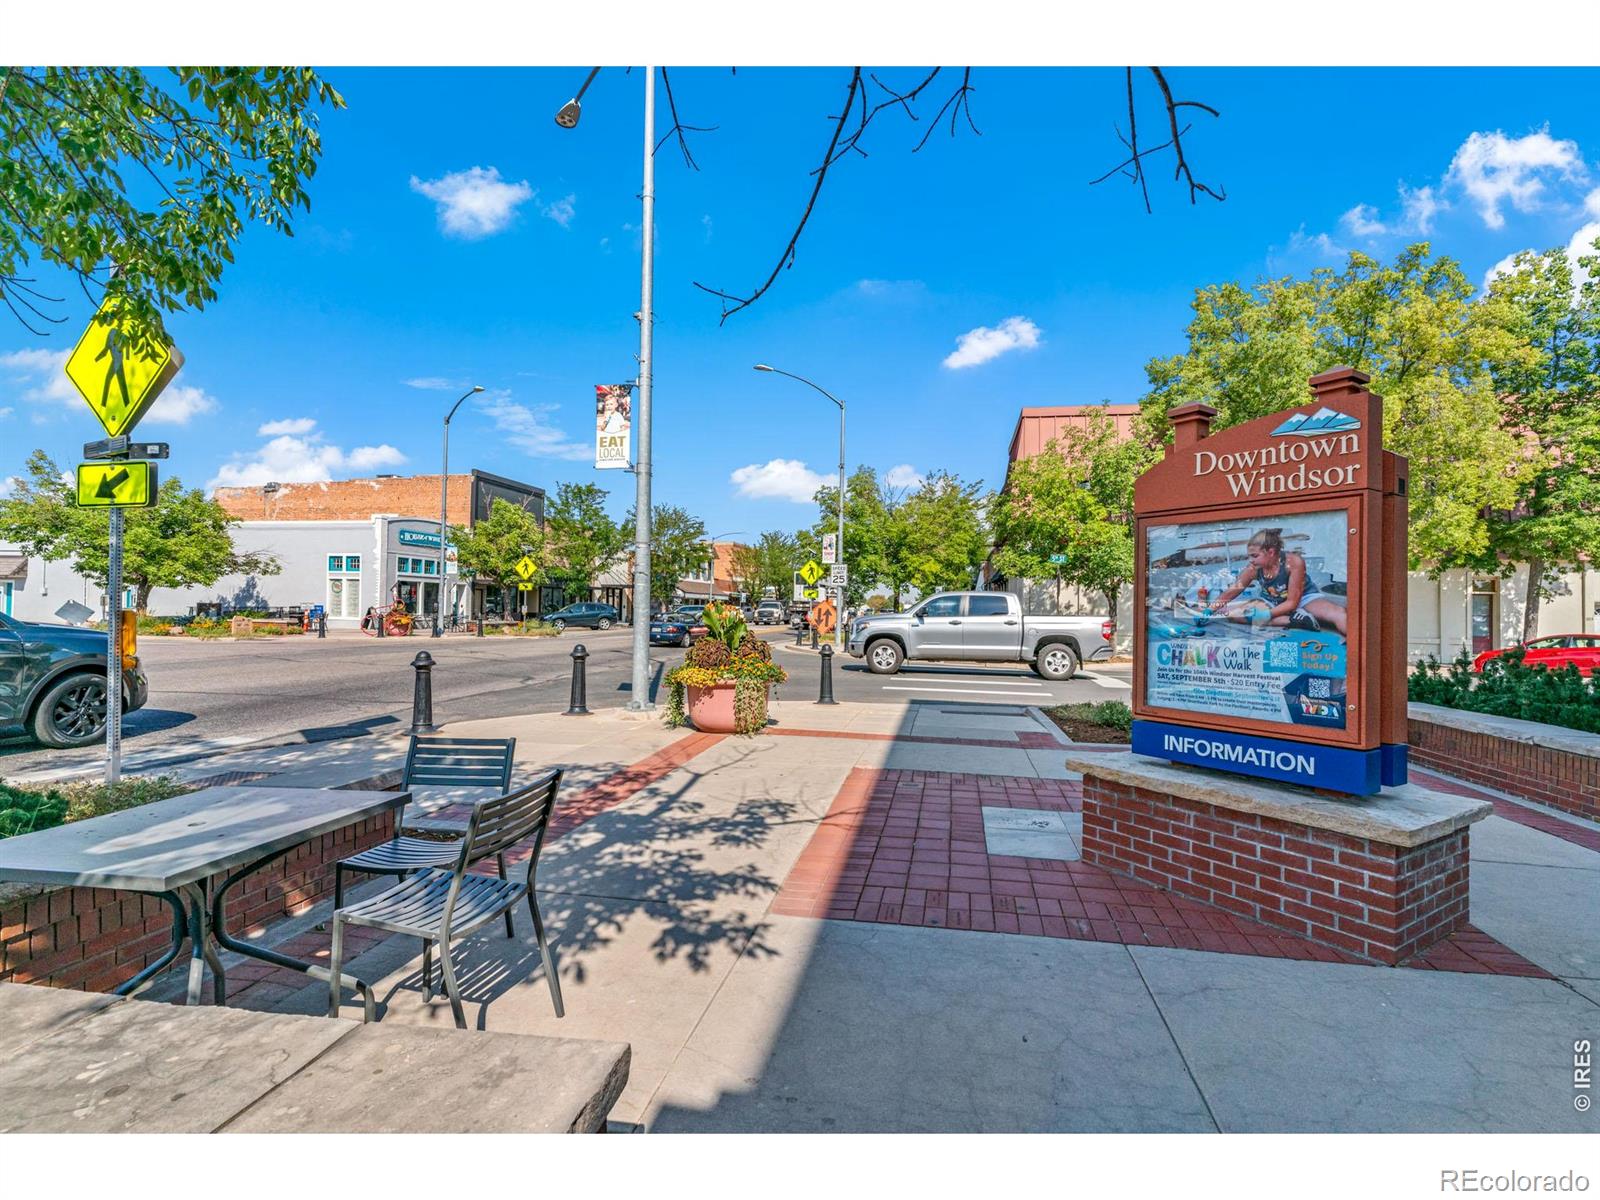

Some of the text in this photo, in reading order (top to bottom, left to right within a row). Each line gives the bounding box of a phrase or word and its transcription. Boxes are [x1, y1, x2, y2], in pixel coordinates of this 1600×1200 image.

[599, 436, 626, 448] EAT
[600, 448, 626, 458] LOCAL
[1193, 432, 1361, 477] Downtown
[1225, 463, 1361, 498] Windsor
[832, 576, 845, 584] 25
[1157, 642, 1221, 669] CHALK
[1223, 646, 1260, 660] On The
[1223, 659, 1252, 671] Walk
[1171, 674, 1212, 684] SEPTEMBER
[1213, 677, 1226, 685] 5th
[1230, 678, 1244, 686] $20
[1244, 680, 1265, 690] Entry
[1266, 682, 1281, 690] Fee
[1164, 734, 1315, 776] INFORMATION
